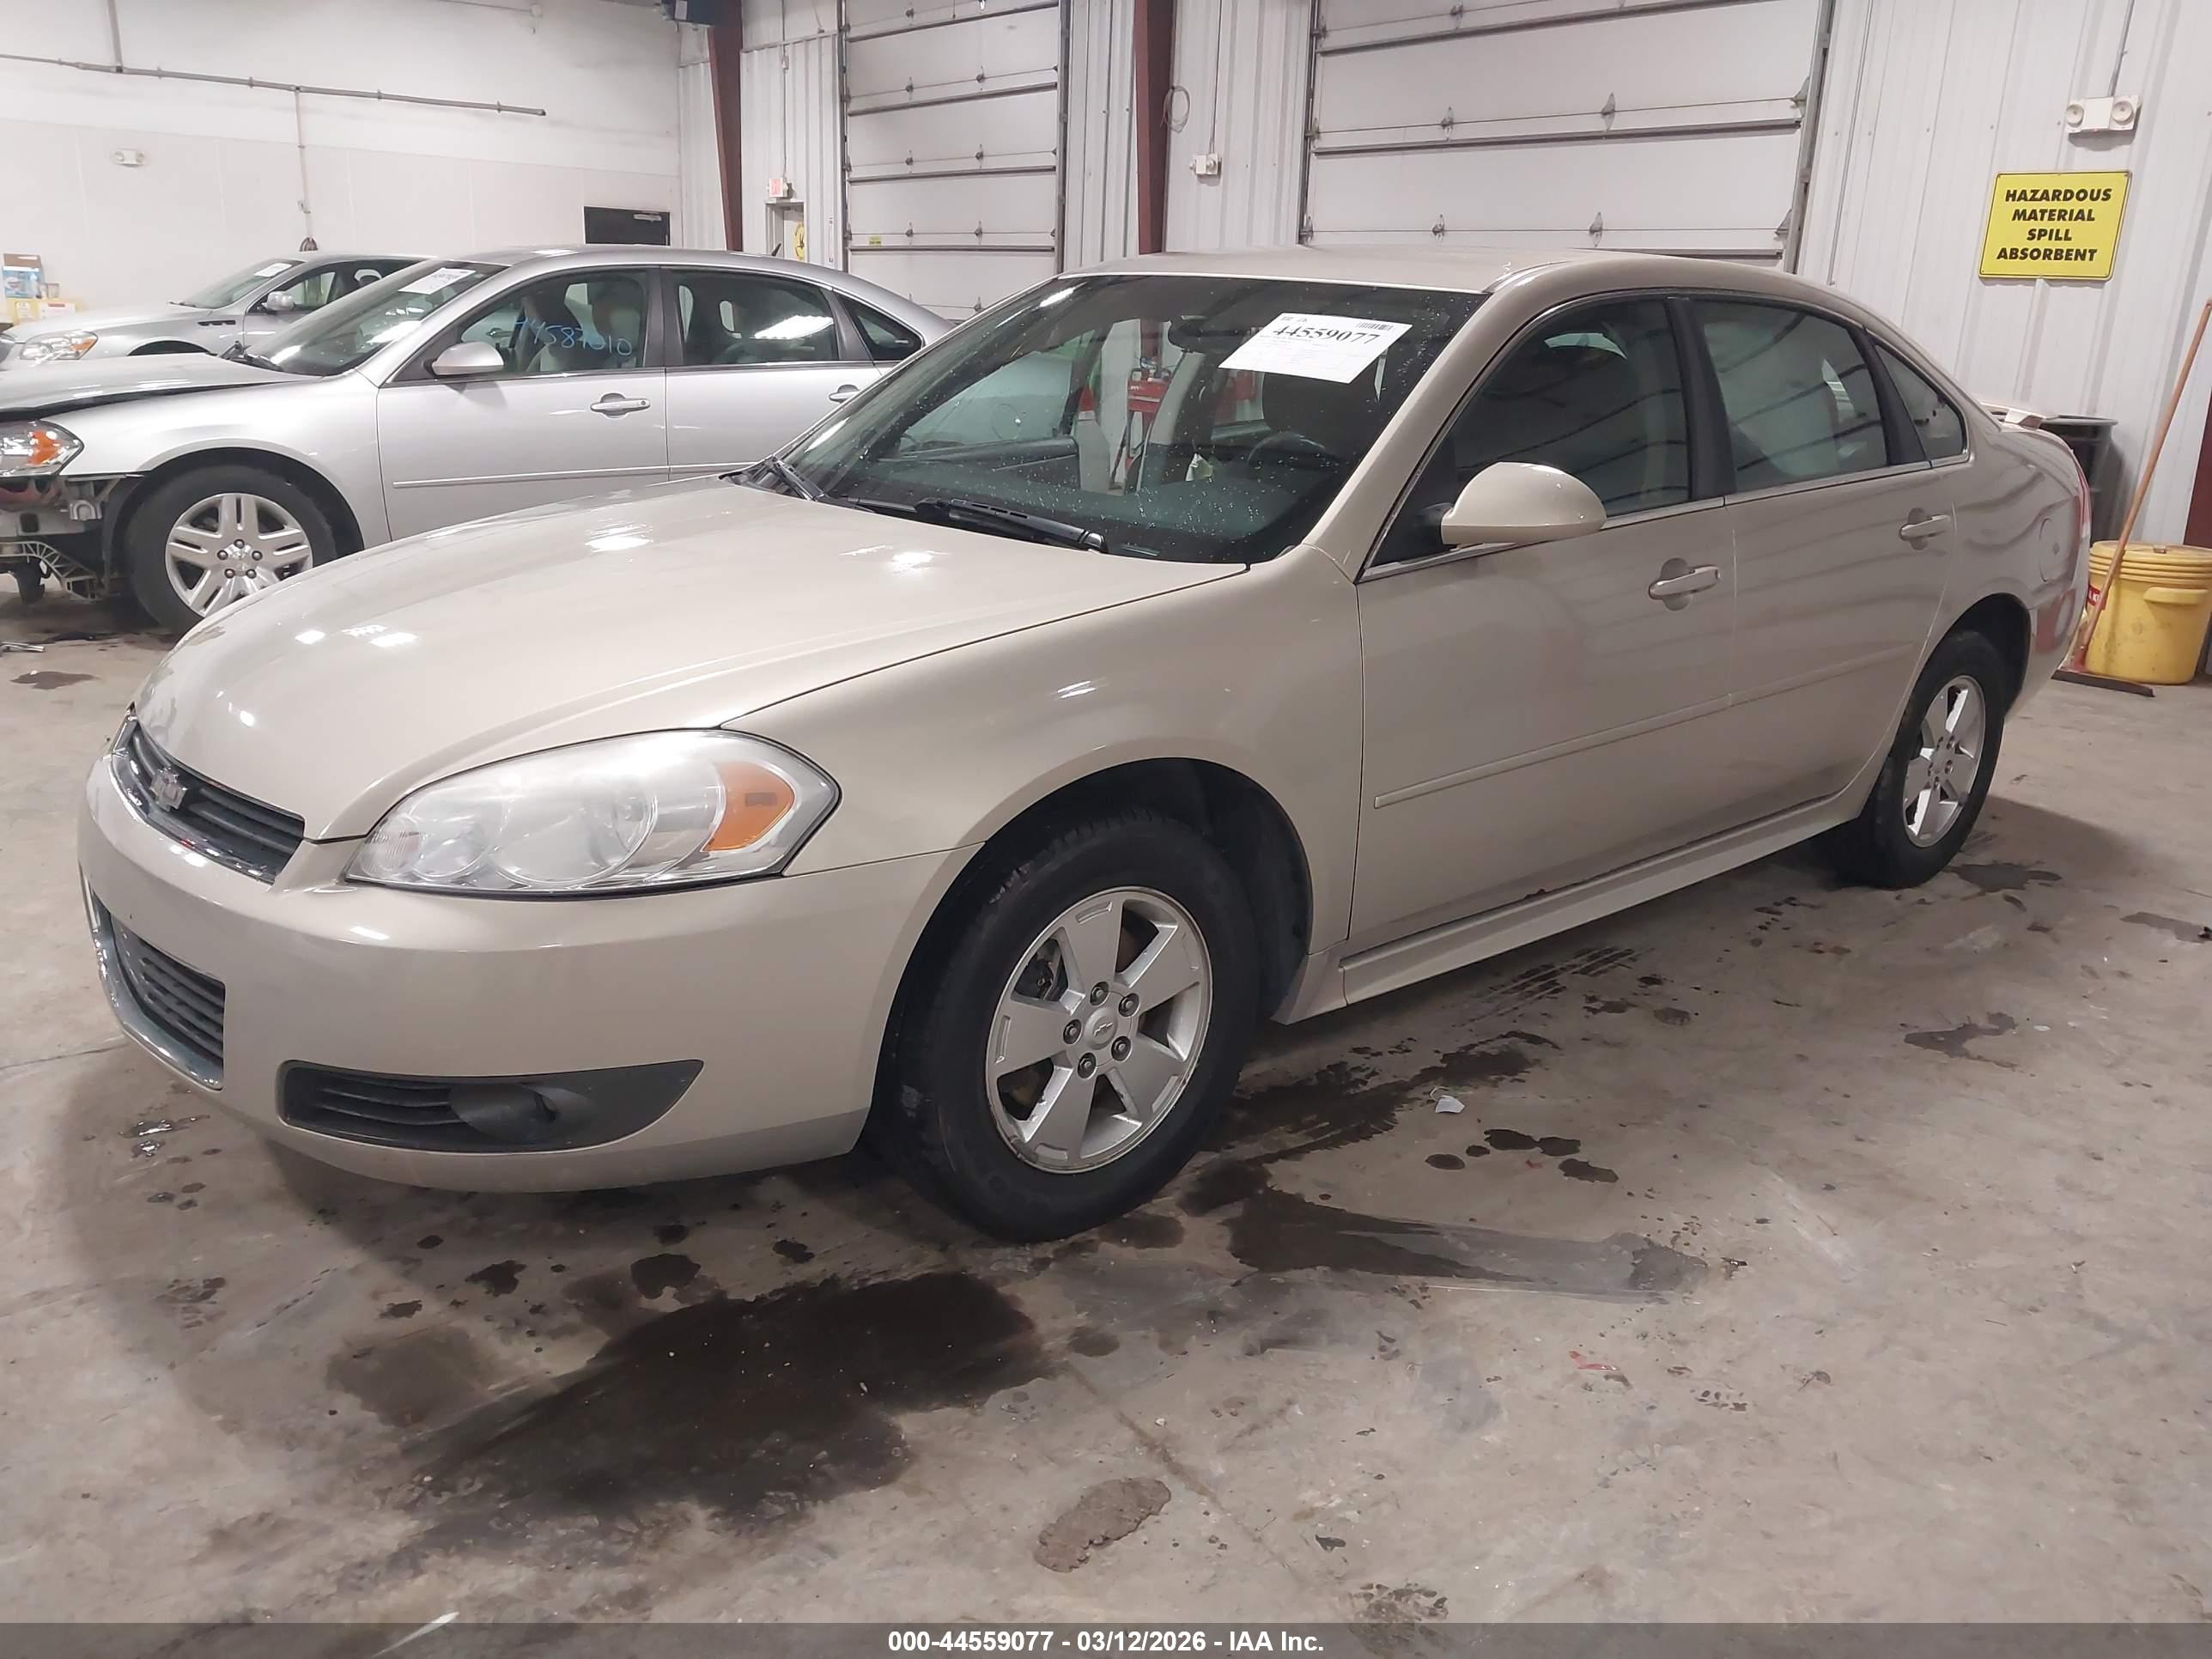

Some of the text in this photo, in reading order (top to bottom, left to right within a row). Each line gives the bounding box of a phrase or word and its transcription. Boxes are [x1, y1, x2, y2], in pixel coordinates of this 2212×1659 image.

[2005, 188, 2112, 202] HAZARDOUS
[2011, 209, 2095, 222] MATERIAL
[2026, 228, 2072, 241] SPILL
[1996, 247, 2098, 262] ABSORBENT
[1273, 325, 1381, 344] 44559077
